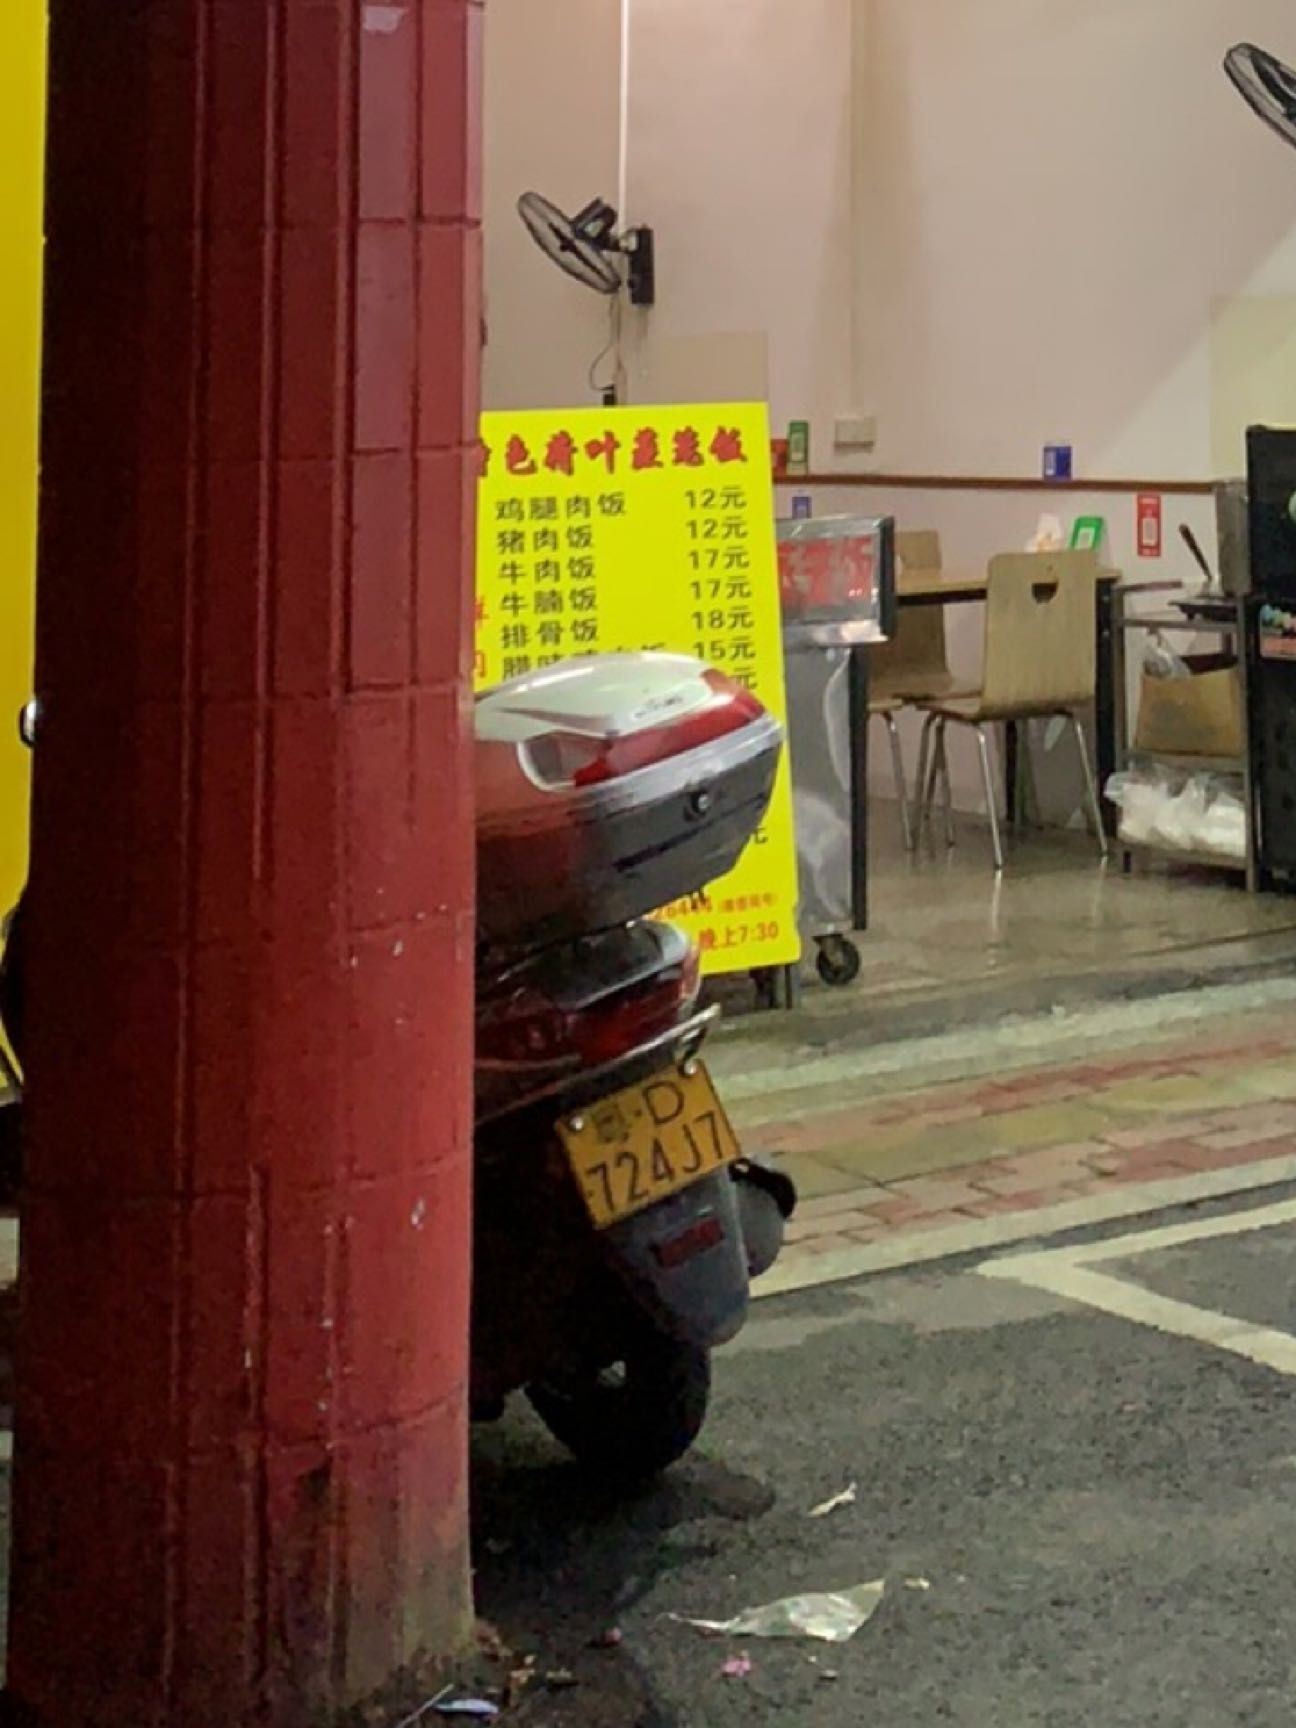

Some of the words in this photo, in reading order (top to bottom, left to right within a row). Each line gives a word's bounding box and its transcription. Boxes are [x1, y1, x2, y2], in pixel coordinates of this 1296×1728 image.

[685, 485, 746, 510] 12元
[686, 516, 748, 540] 12元
[499, 555, 596, 585] 牛肉饭
[688, 548, 750, 570] 17元
[690, 579, 752, 601] 17元
[501, 618, 598, 649] 排骨饭
[692, 609, 754, 631] 18元
